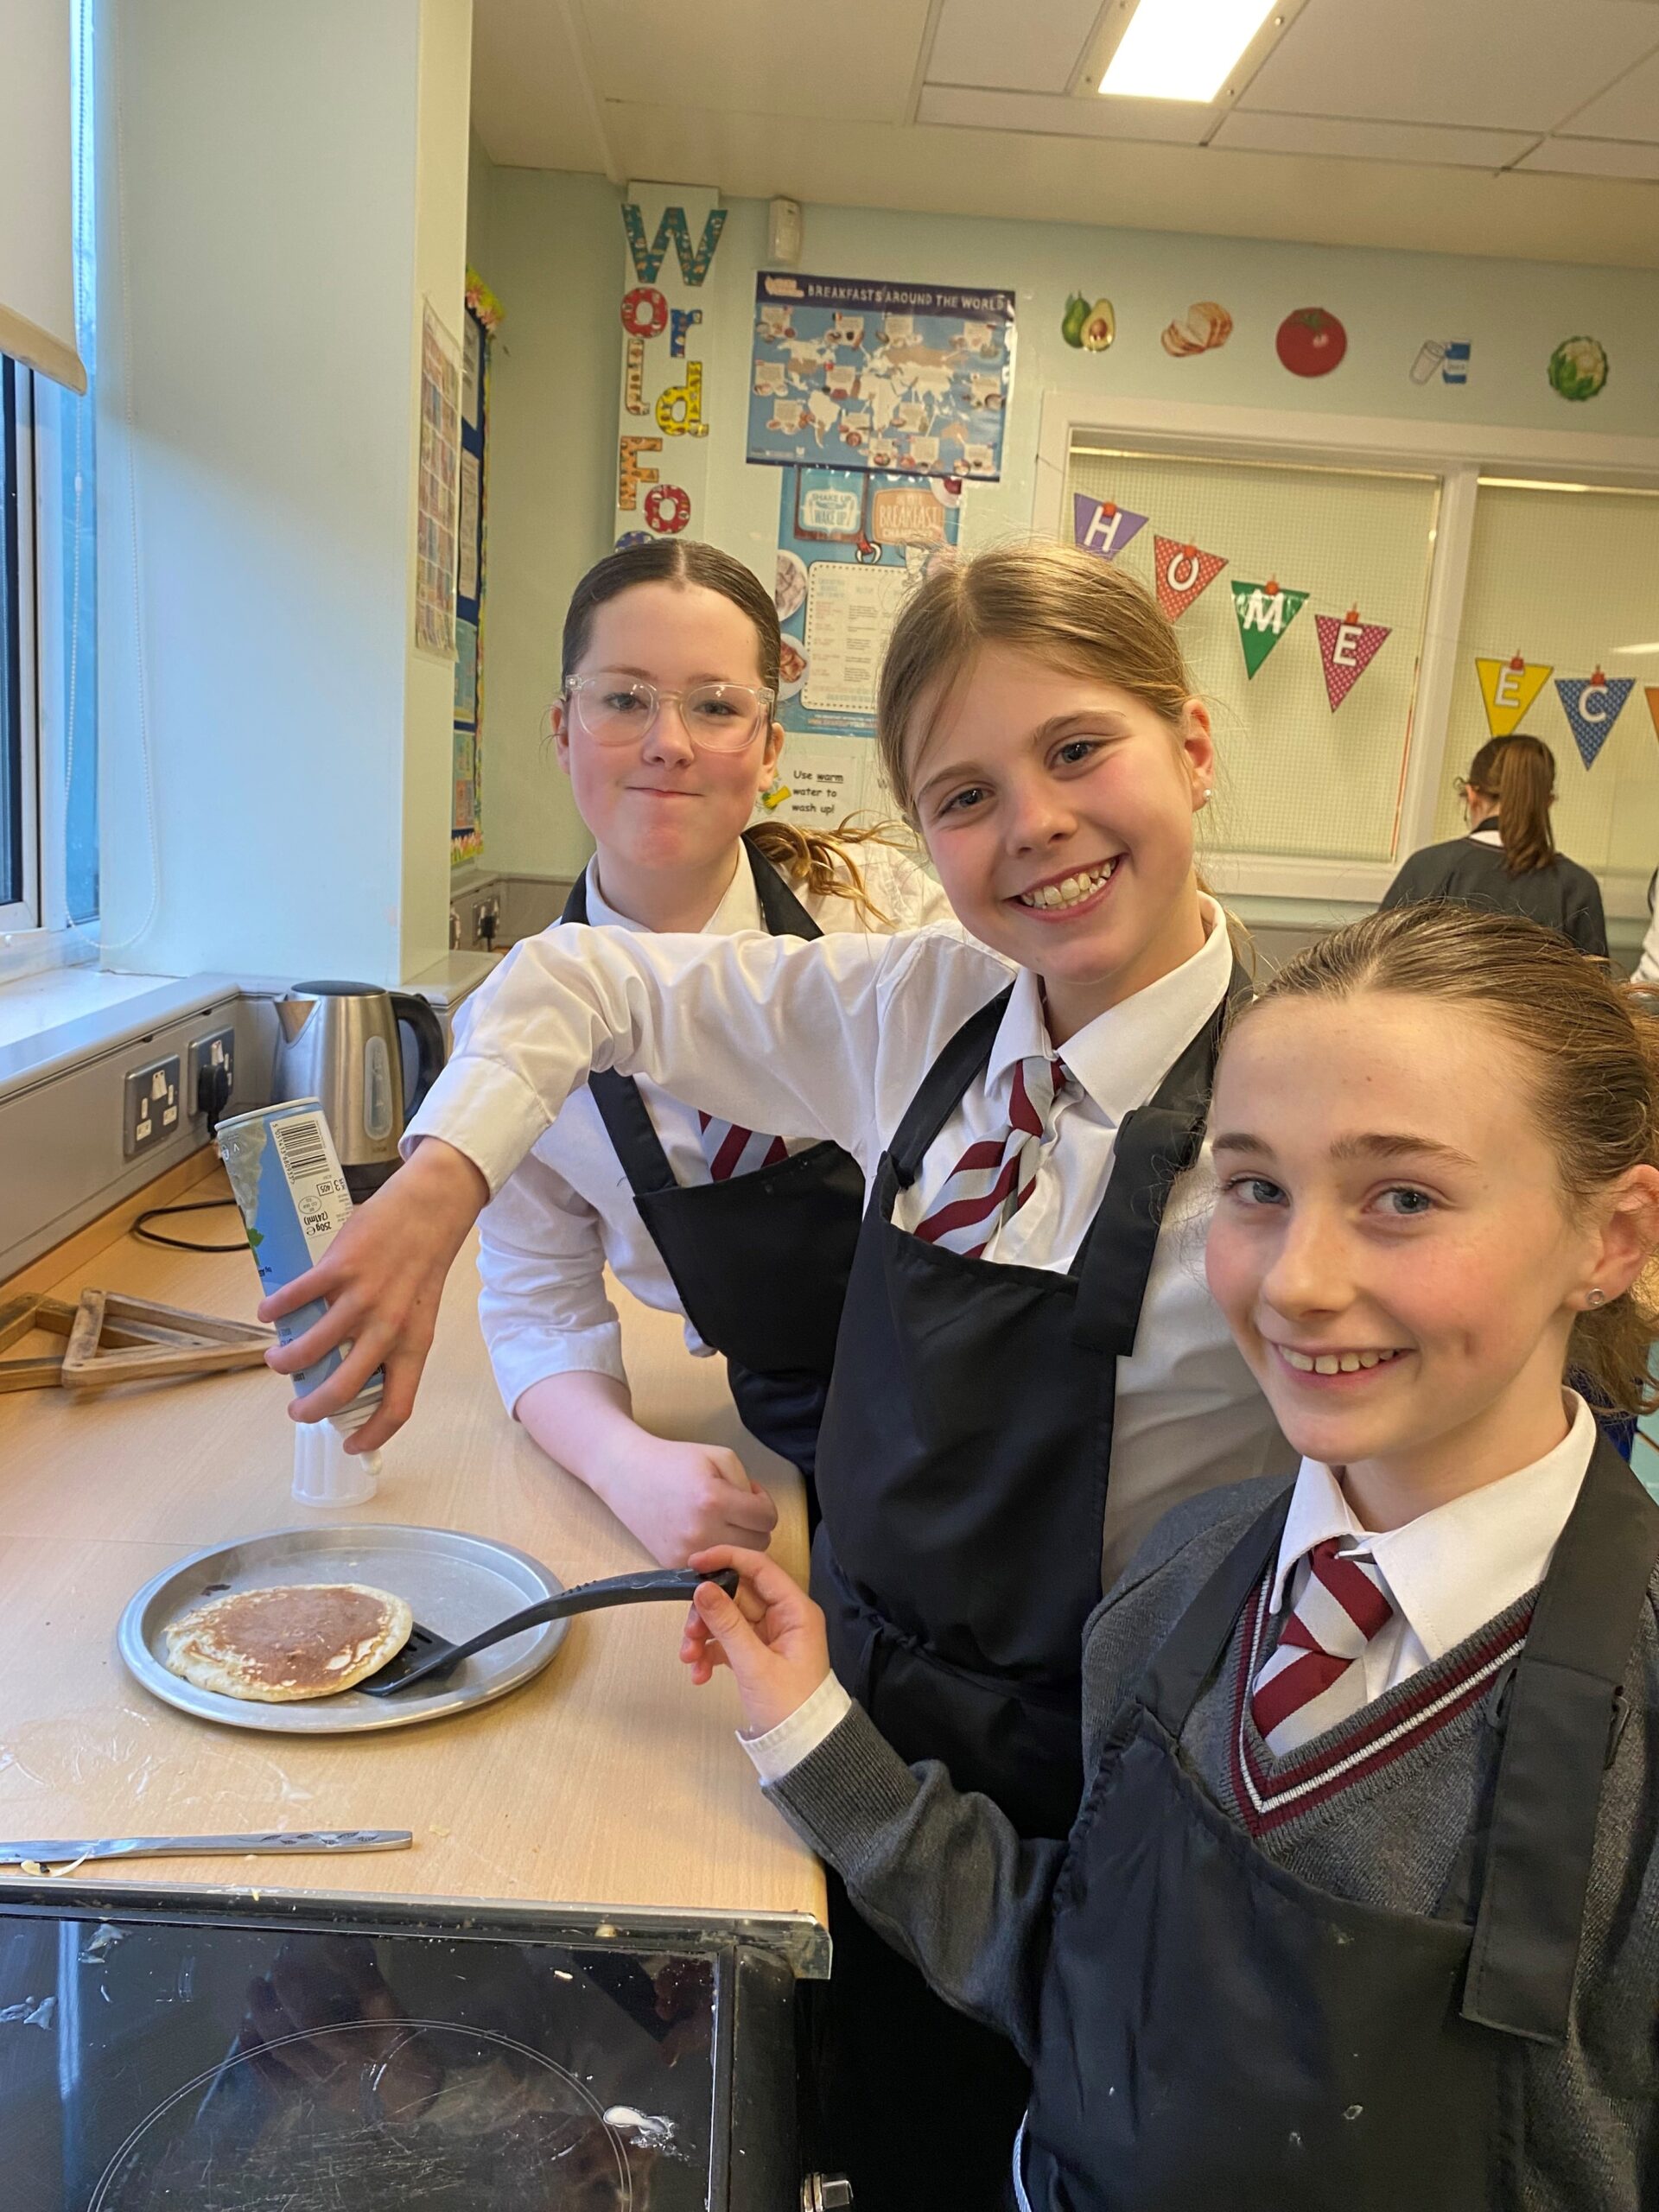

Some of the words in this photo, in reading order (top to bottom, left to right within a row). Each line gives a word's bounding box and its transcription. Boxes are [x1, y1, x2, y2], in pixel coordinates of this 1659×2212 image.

[808, 284, 882, 302] BREAKFASTS
[885, 290, 931, 305] AROUND
[936, 295, 958, 308] THE
[812, 493, 839, 502] SHAKE
[840, 494, 852, 503] UP
[815, 511, 835, 525] WAKE
[836, 512, 848, 526] UP
[879, 505, 938, 529] BREAKFAST
[793, 770, 812, 779] Use
[817, 773, 843, 783] warm
[793, 787, 823, 797] water
[827, 789, 837, 798] to
[791, 804, 817, 812] wash
[820, 804, 835, 816] up!
[304, 1211, 328, 1225] (241ml)
[316, 1222, 332, 1231] 250g
